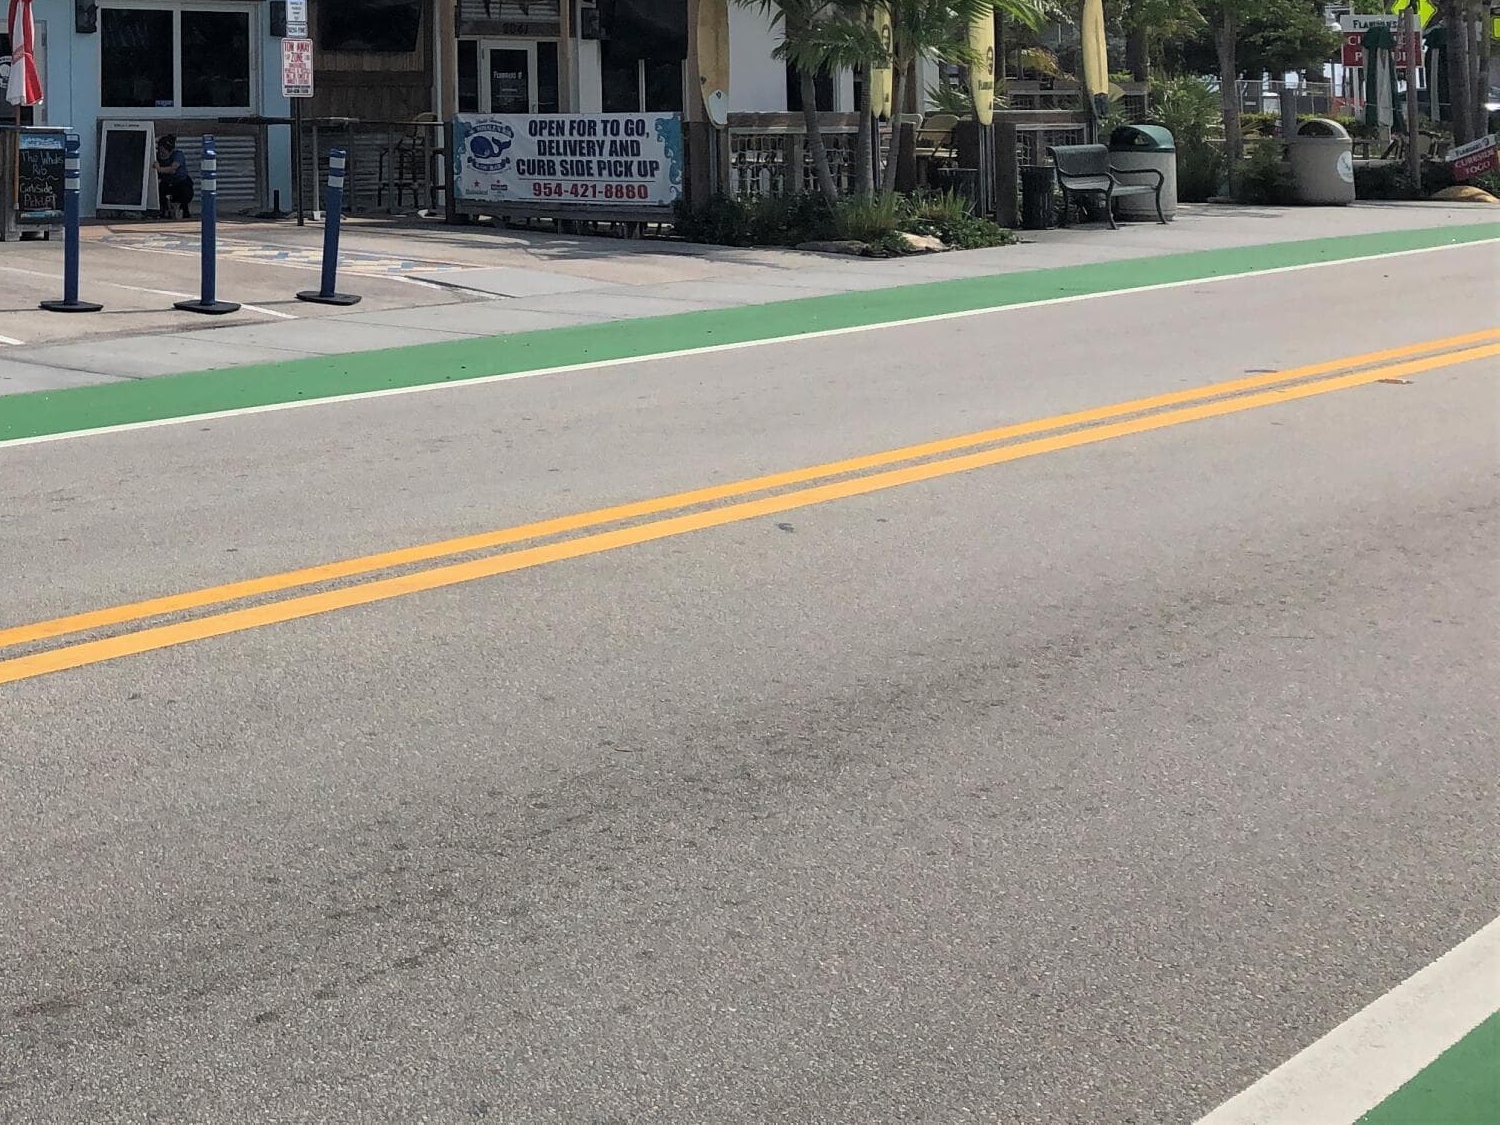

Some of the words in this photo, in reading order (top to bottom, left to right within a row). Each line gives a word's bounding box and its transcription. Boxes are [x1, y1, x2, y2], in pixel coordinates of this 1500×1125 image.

[528, 119, 566, 137] OPEN
[568, 119, 599, 137] FOR
[600, 119, 620, 137] TO
[624, 119, 650, 139] GO,
[537, 139, 607, 157] DELIVERY
[608, 139, 641, 157] AND
[516, 159, 556, 176] CURB
[559, 159, 594, 177] SIDE
[597, 159, 637, 178] PICK
[638, 160, 660, 178] UP
[532, 182, 649, 199] 954-421-8880
